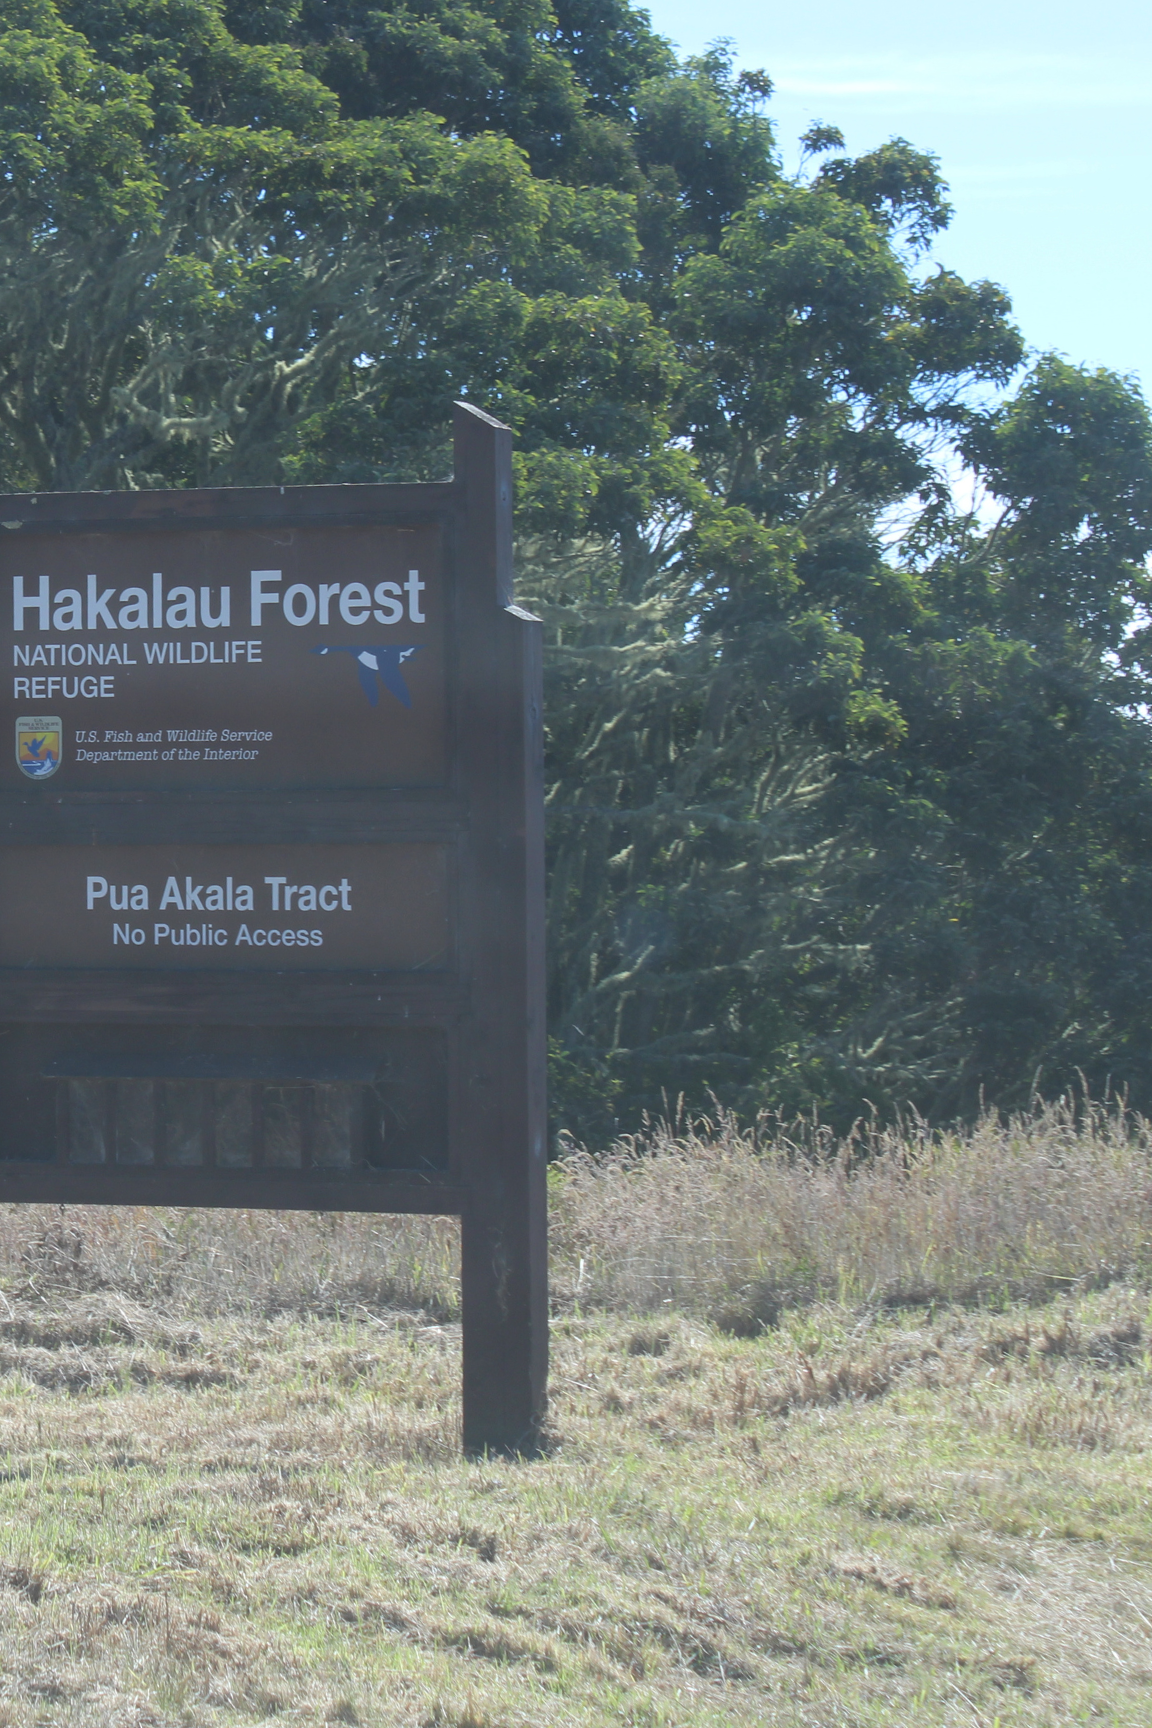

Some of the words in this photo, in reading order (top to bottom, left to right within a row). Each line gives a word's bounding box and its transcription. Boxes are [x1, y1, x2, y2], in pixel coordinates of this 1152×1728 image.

[13, 573, 230, 631] Hakalau
[251, 569, 425, 627] Forest
[14, 643, 137, 666] NATIONAL
[144, 641, 262, 664] WILDLIFE
[14, 676, 114, 699] REFUGE
[75, 730, 100, 743] U.S.
[103, 730, 133, 743] Fish
[135, 729, 163, 743] and
[166, 728, 218, 742] Wildlife
[220, 728, 273, 742] Service
[75, 748, 159, 764] Department
[161, 747, 178, 762] of
[178, 747, 201, 761] the
[202, 747, 259, 761] Interior
[87, 876, 148, 911] Pua
[159, 876, 254, 911] Akala
[264, 877, 352, 912] Tract
[112, 923, 146, 946] No
[155, 923, 228, 946] Public
[235, 924, 323, 947] Access
